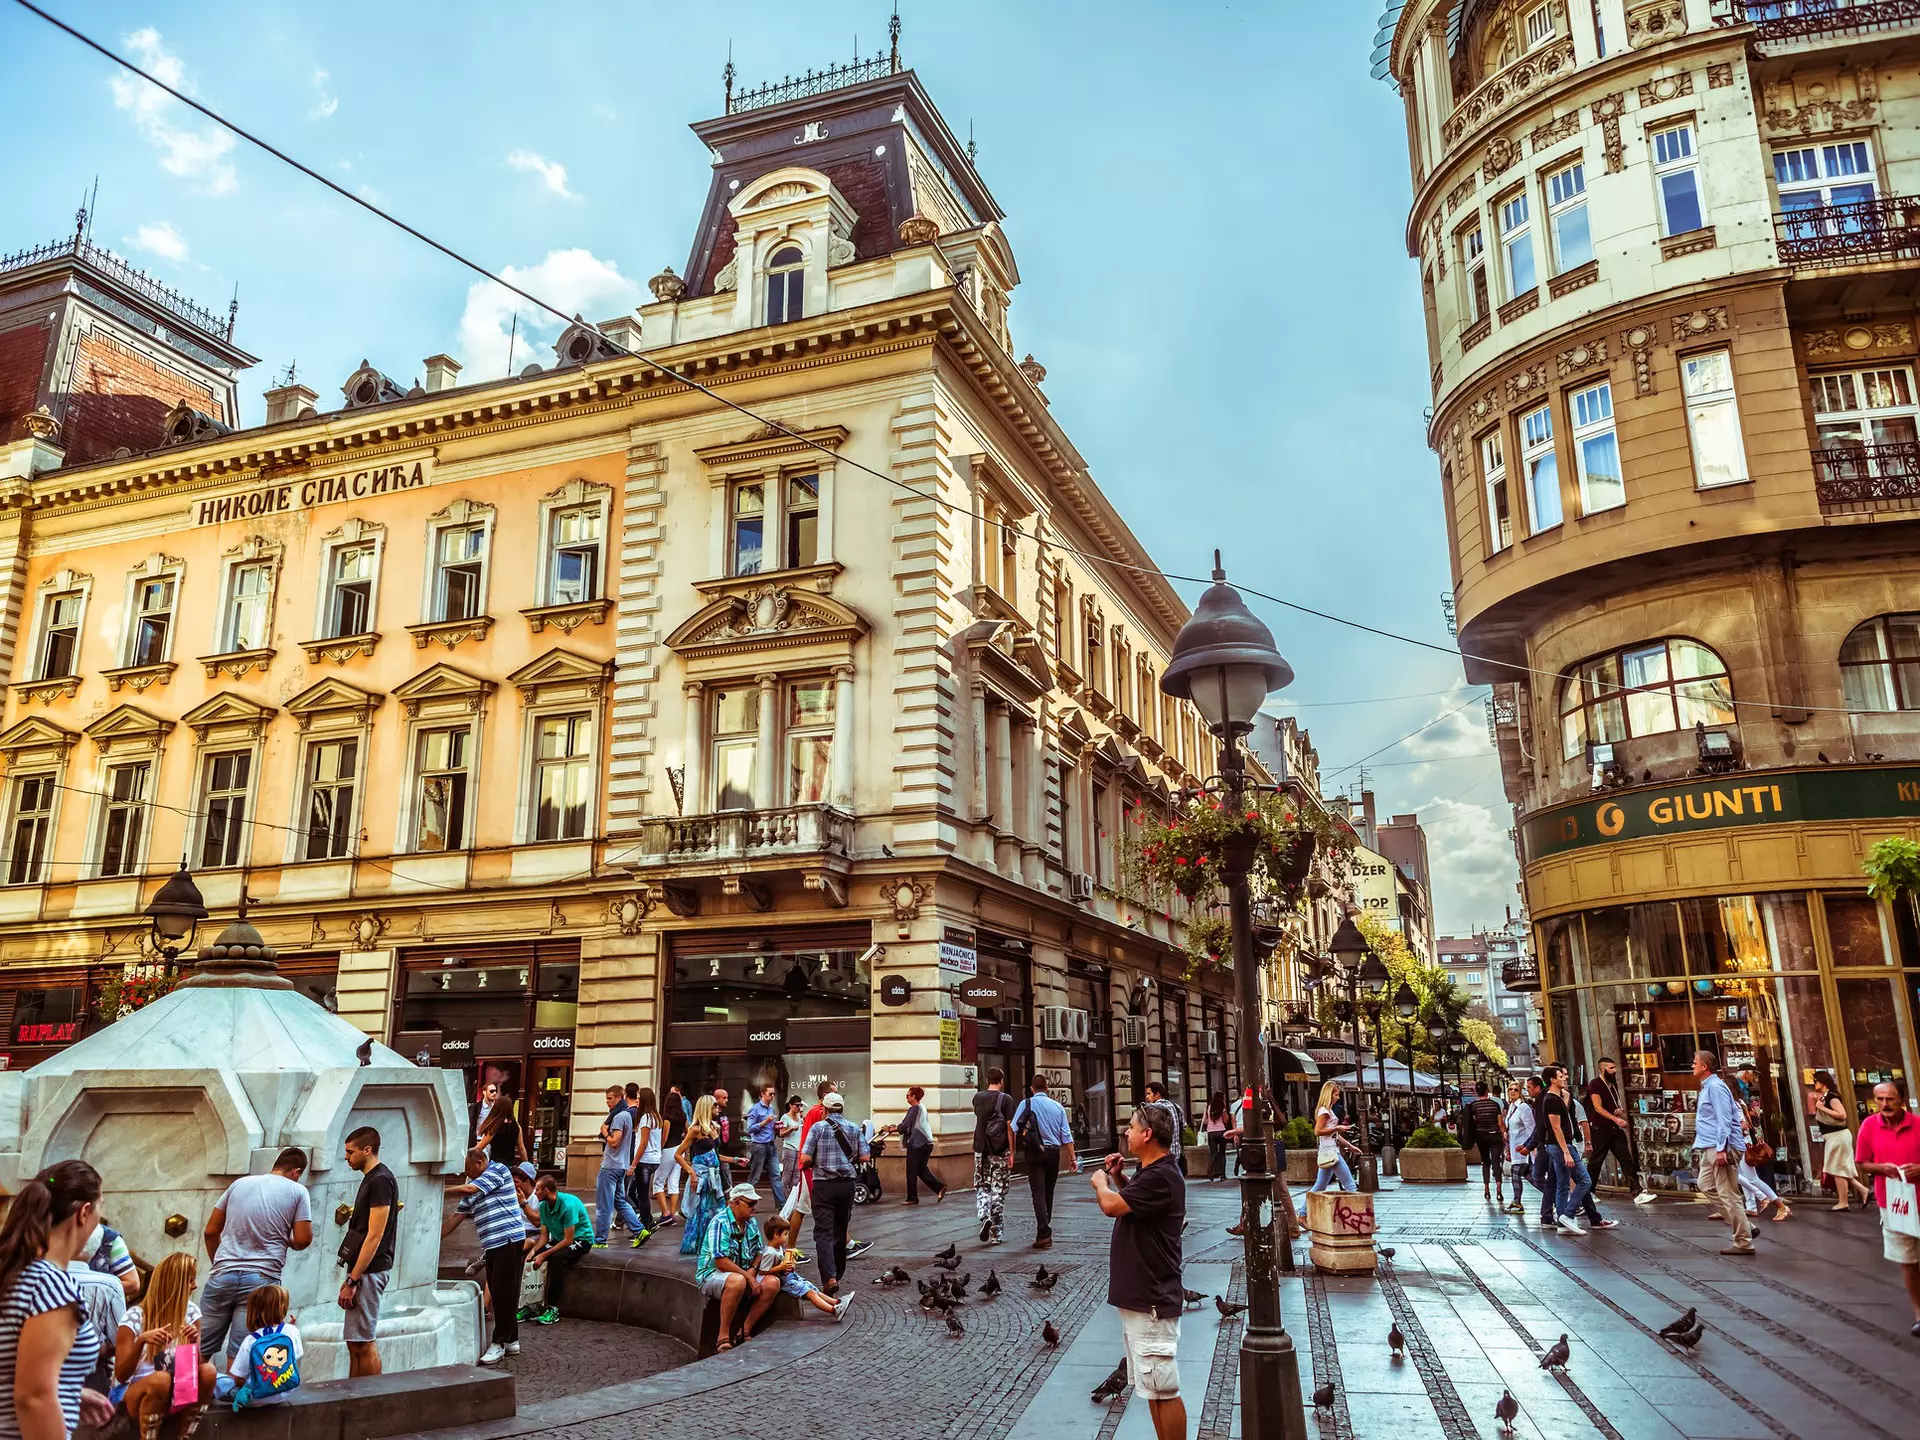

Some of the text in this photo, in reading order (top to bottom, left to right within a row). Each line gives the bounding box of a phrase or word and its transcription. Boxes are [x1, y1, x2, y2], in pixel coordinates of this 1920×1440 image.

[198, 461, 424, 526] НИКОЛЕ СПАСИЋА
[1647, 784, 1782, 825] GIUNTI
[967, 988, 998, 997] adidas
[18, 1023, 76, 1042] REPLAY
[749, 1031, 782, 1041] adidas
[442, 1040, 470, 1050] adidas
[533, 1036, 571, 1049] adidas
[790, 1080, 846, 1089] EVERYNG
